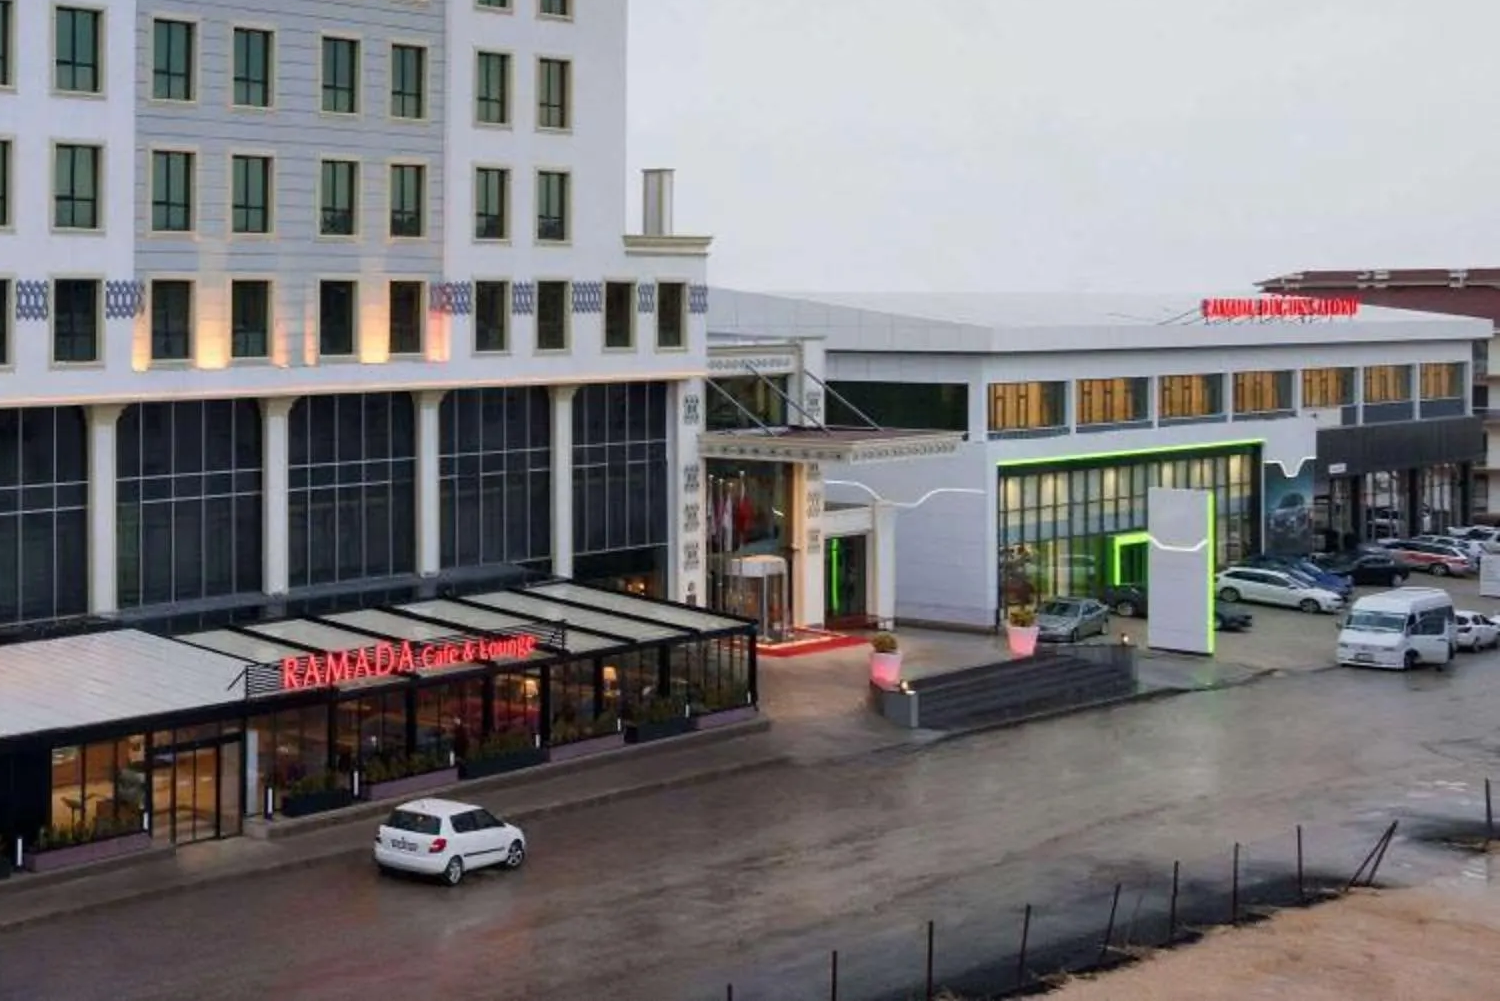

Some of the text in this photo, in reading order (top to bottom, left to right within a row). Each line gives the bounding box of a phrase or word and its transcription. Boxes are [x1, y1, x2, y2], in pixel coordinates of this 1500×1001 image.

[283, 634, 536, 689] RAMADA Cafe & Lounge
